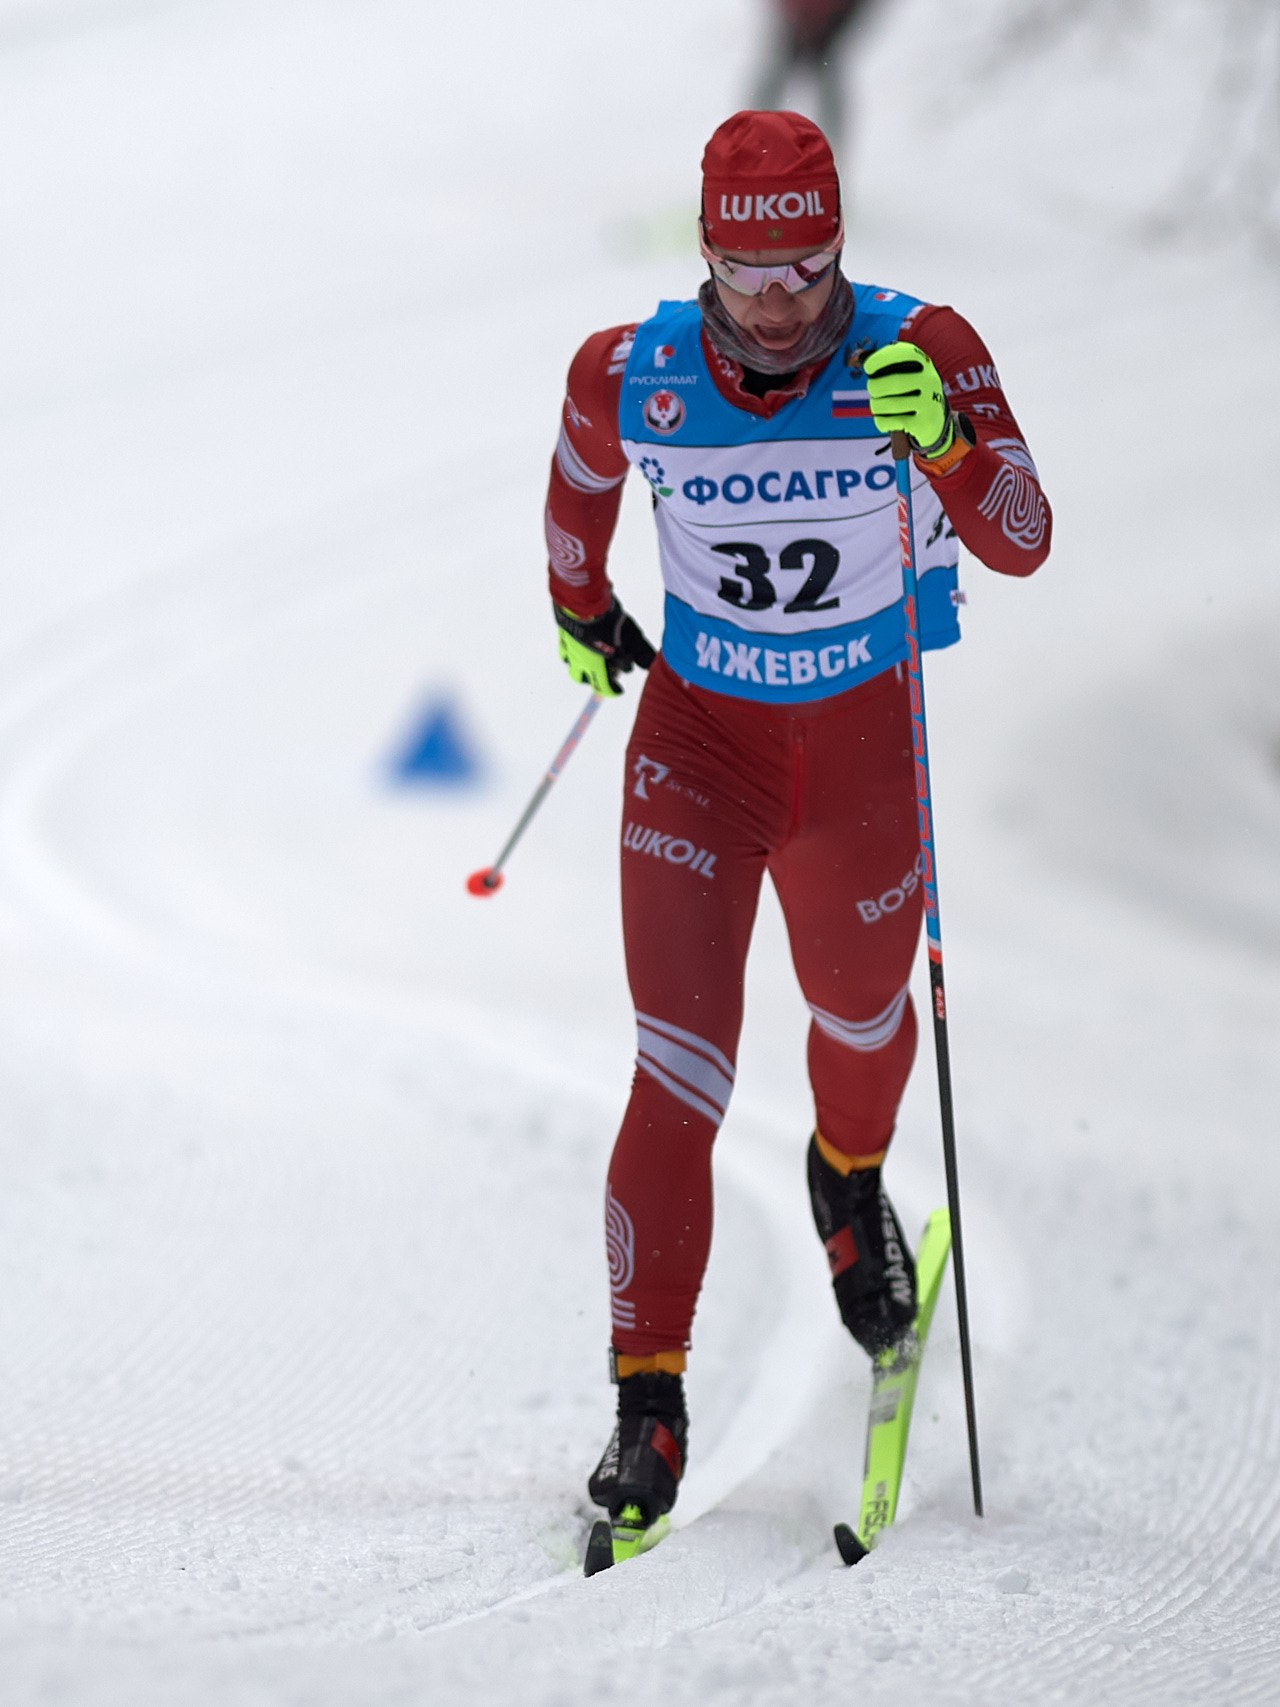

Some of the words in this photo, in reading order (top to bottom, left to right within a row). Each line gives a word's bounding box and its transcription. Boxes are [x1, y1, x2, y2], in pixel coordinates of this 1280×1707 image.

[720, 189, 825, 222] LUKOIL
[682, 464, 896, 505] ФОСАГРО
[710, 538, 841, 614] 32
[694, 633, 873, 686] ИЖЕВСК
[623, 821, 717, 879] LUKOIL
